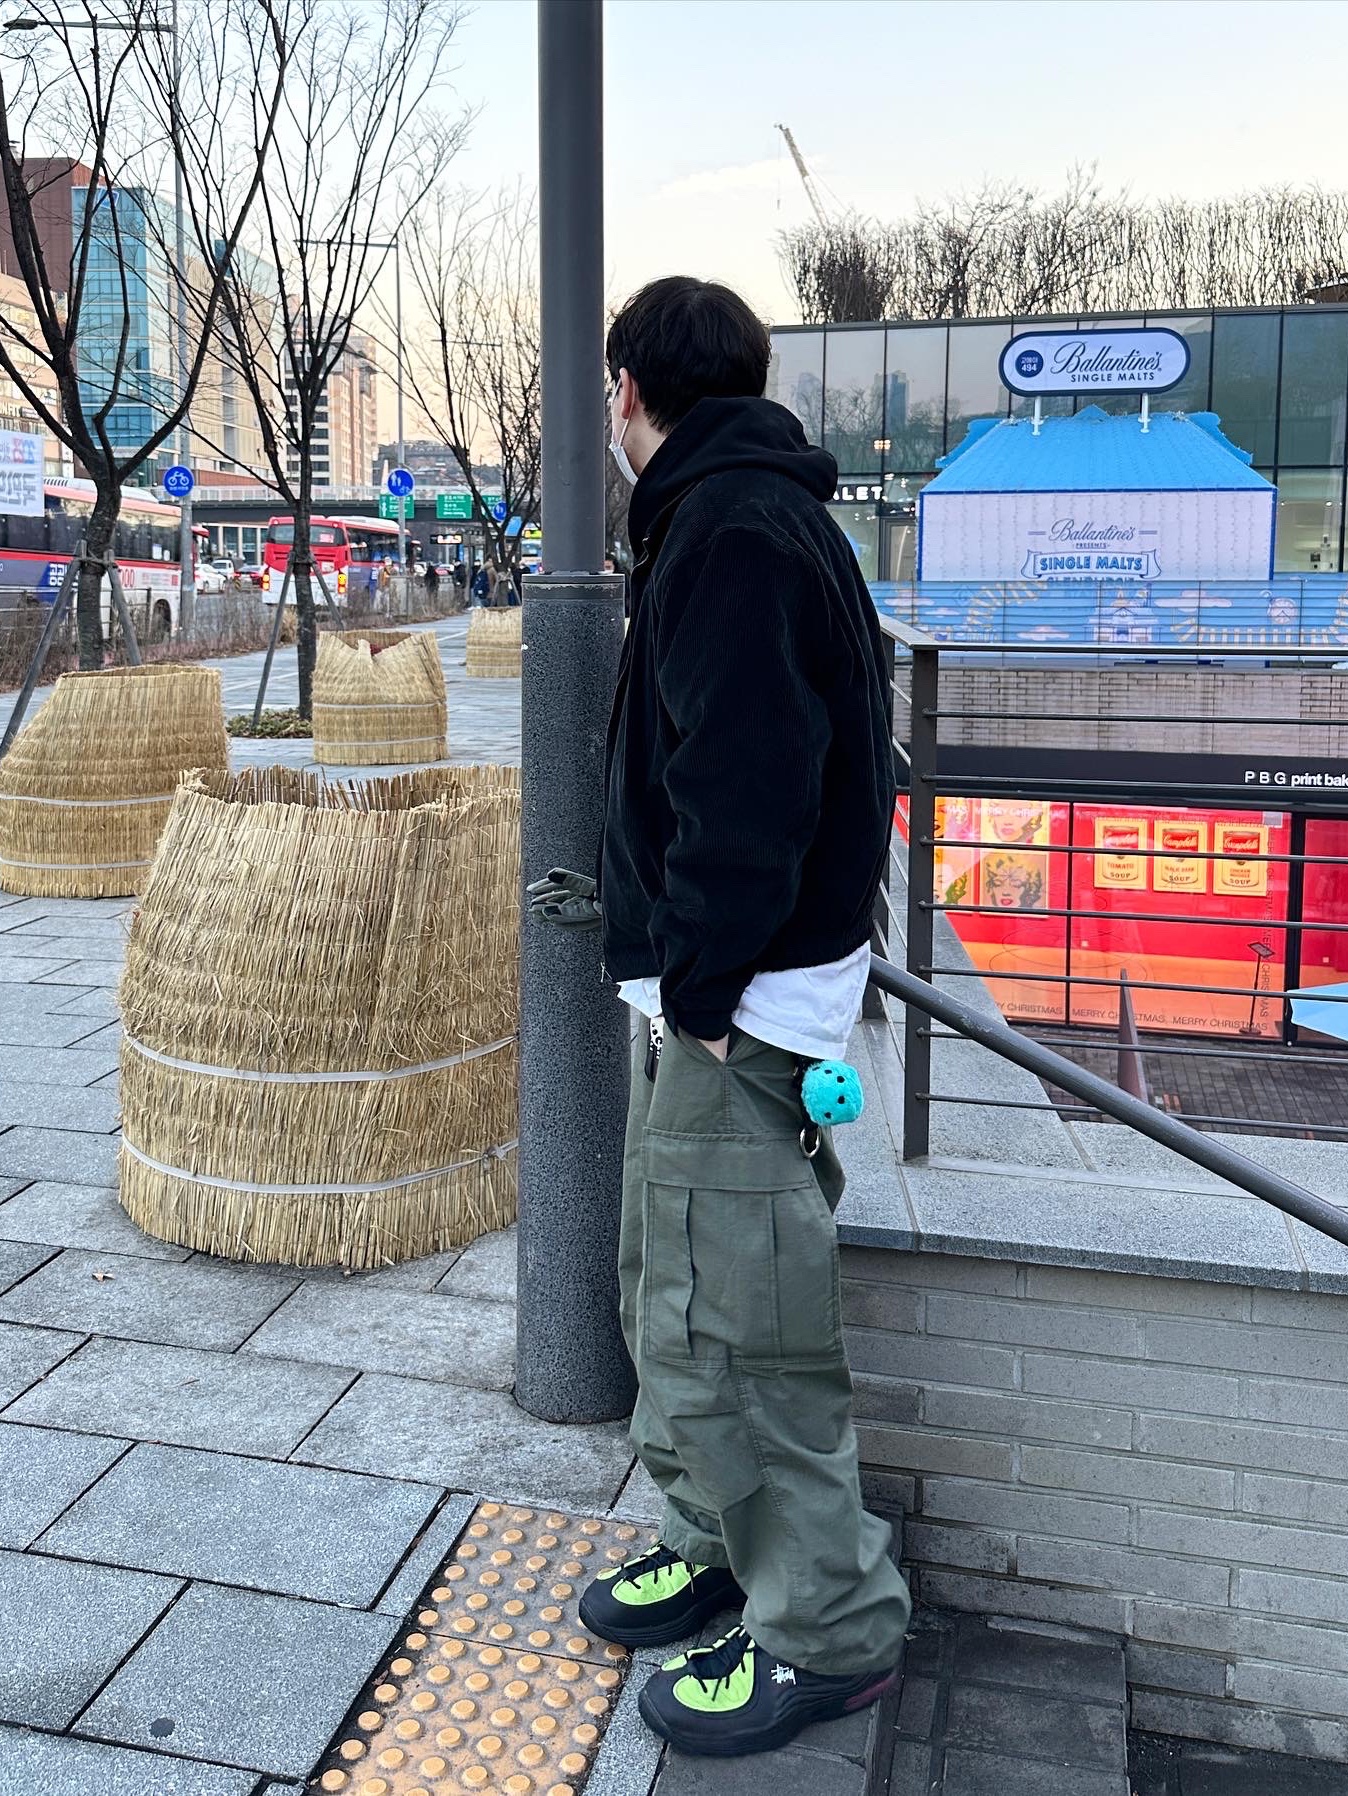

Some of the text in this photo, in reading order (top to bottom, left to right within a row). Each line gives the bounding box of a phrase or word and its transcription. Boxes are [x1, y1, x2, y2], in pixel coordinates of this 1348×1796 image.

[1050, 341, 1162, 374] Ballantine's
[1021, 364, 1038, 372] 494
[1071, 372, 1155, 383] SINGLE MALTS
[1049, 518, 1136, 542] Ballantine's
[1040, 556, 1142, 571] SINGLE MALTS
[1291, 773, 1322, 787] print
[1229, 878, 1251, 886] SOUP
[1260, 964, 1271, 1017] CHRISMAS
[1072, 1008, 1105, 1019] MERRY
[1172, 1016, 1207, 1027] MERRY
